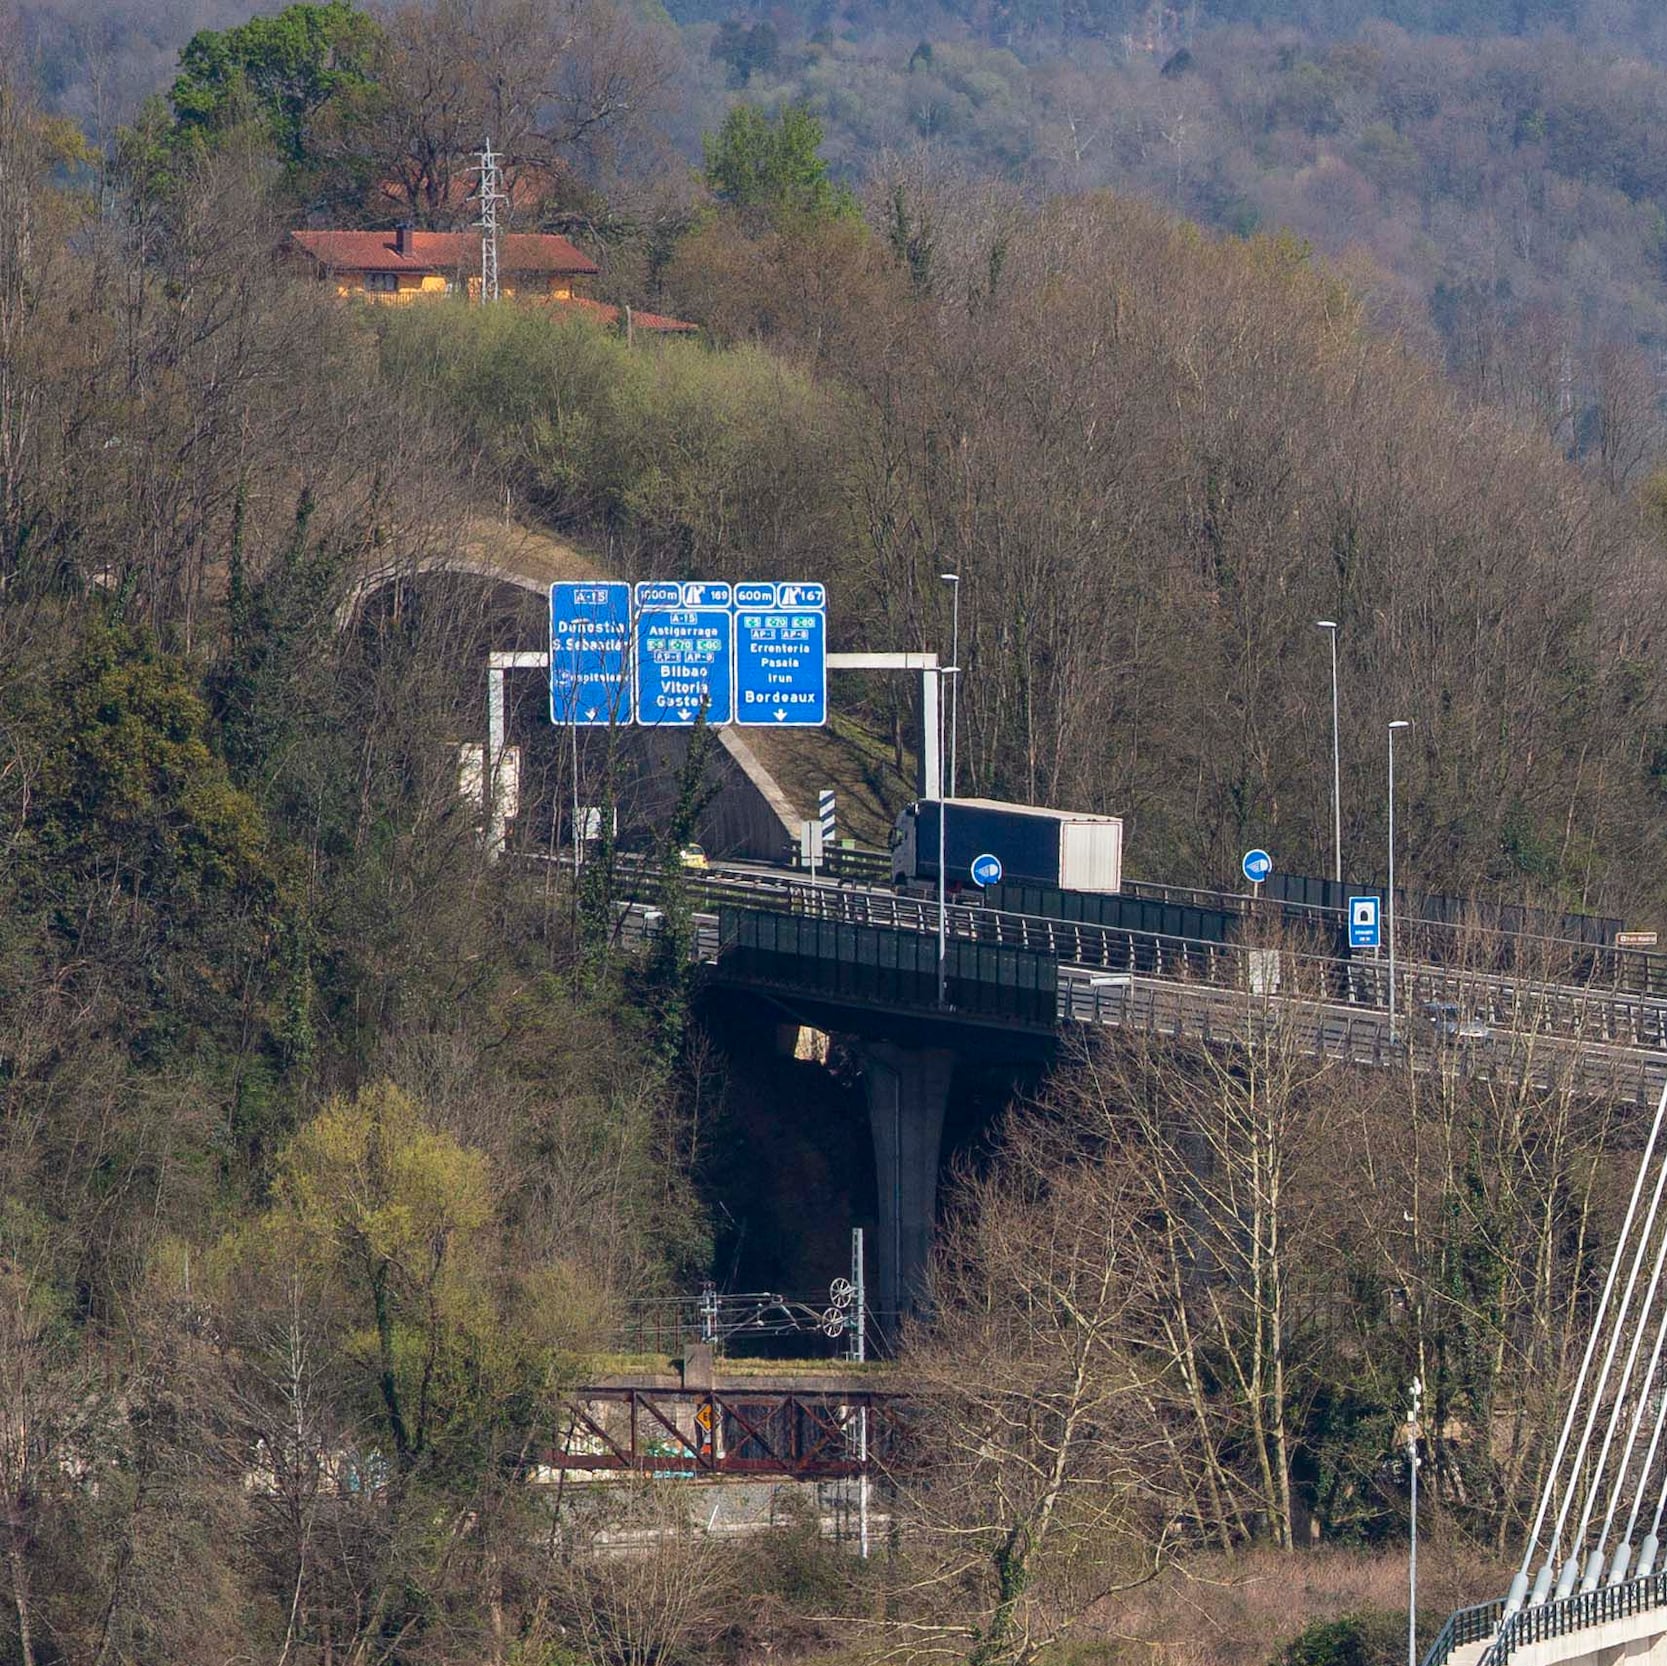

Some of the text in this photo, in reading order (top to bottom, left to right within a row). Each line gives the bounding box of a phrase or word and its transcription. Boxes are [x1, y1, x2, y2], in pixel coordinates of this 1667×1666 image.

[577, 592, 606, 602] A-15
[711, 591, 727, 600] 169
[801, 591, 823, 601] 167
[672, 614, 696, 623] A-15
[558, 621, 625, 633] Donostia
[649, 626, 718, 637] Astigarraga
[750, 643, 810, 653] Errenteria
[761, 657, 799, 668] Pasaia
[660, 665, 708, 677] Bilbao
[768, 673, 793, 683] Irun
[661, 680, 708, 694] Vitoria
[745, 690, 815, 703] Bordeaux
